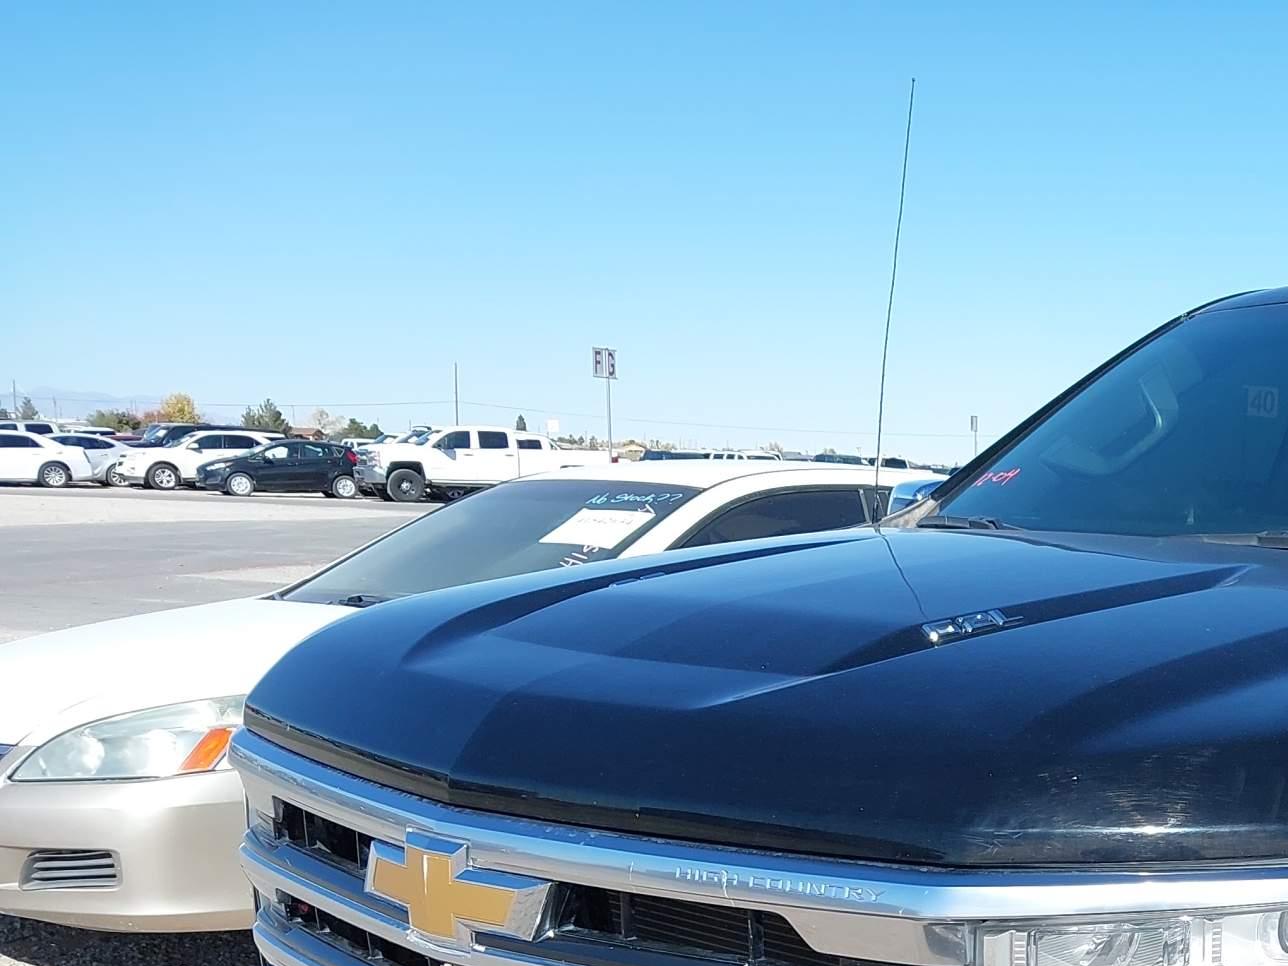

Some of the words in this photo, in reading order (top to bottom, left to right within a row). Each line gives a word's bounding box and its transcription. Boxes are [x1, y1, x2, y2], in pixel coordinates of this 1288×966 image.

[595, 350, 601, 375] F
[608, 351, 615, 377] G
[675, 866, 738, 886] HIGH
[749, 876, 887, 902] COUNTRY
